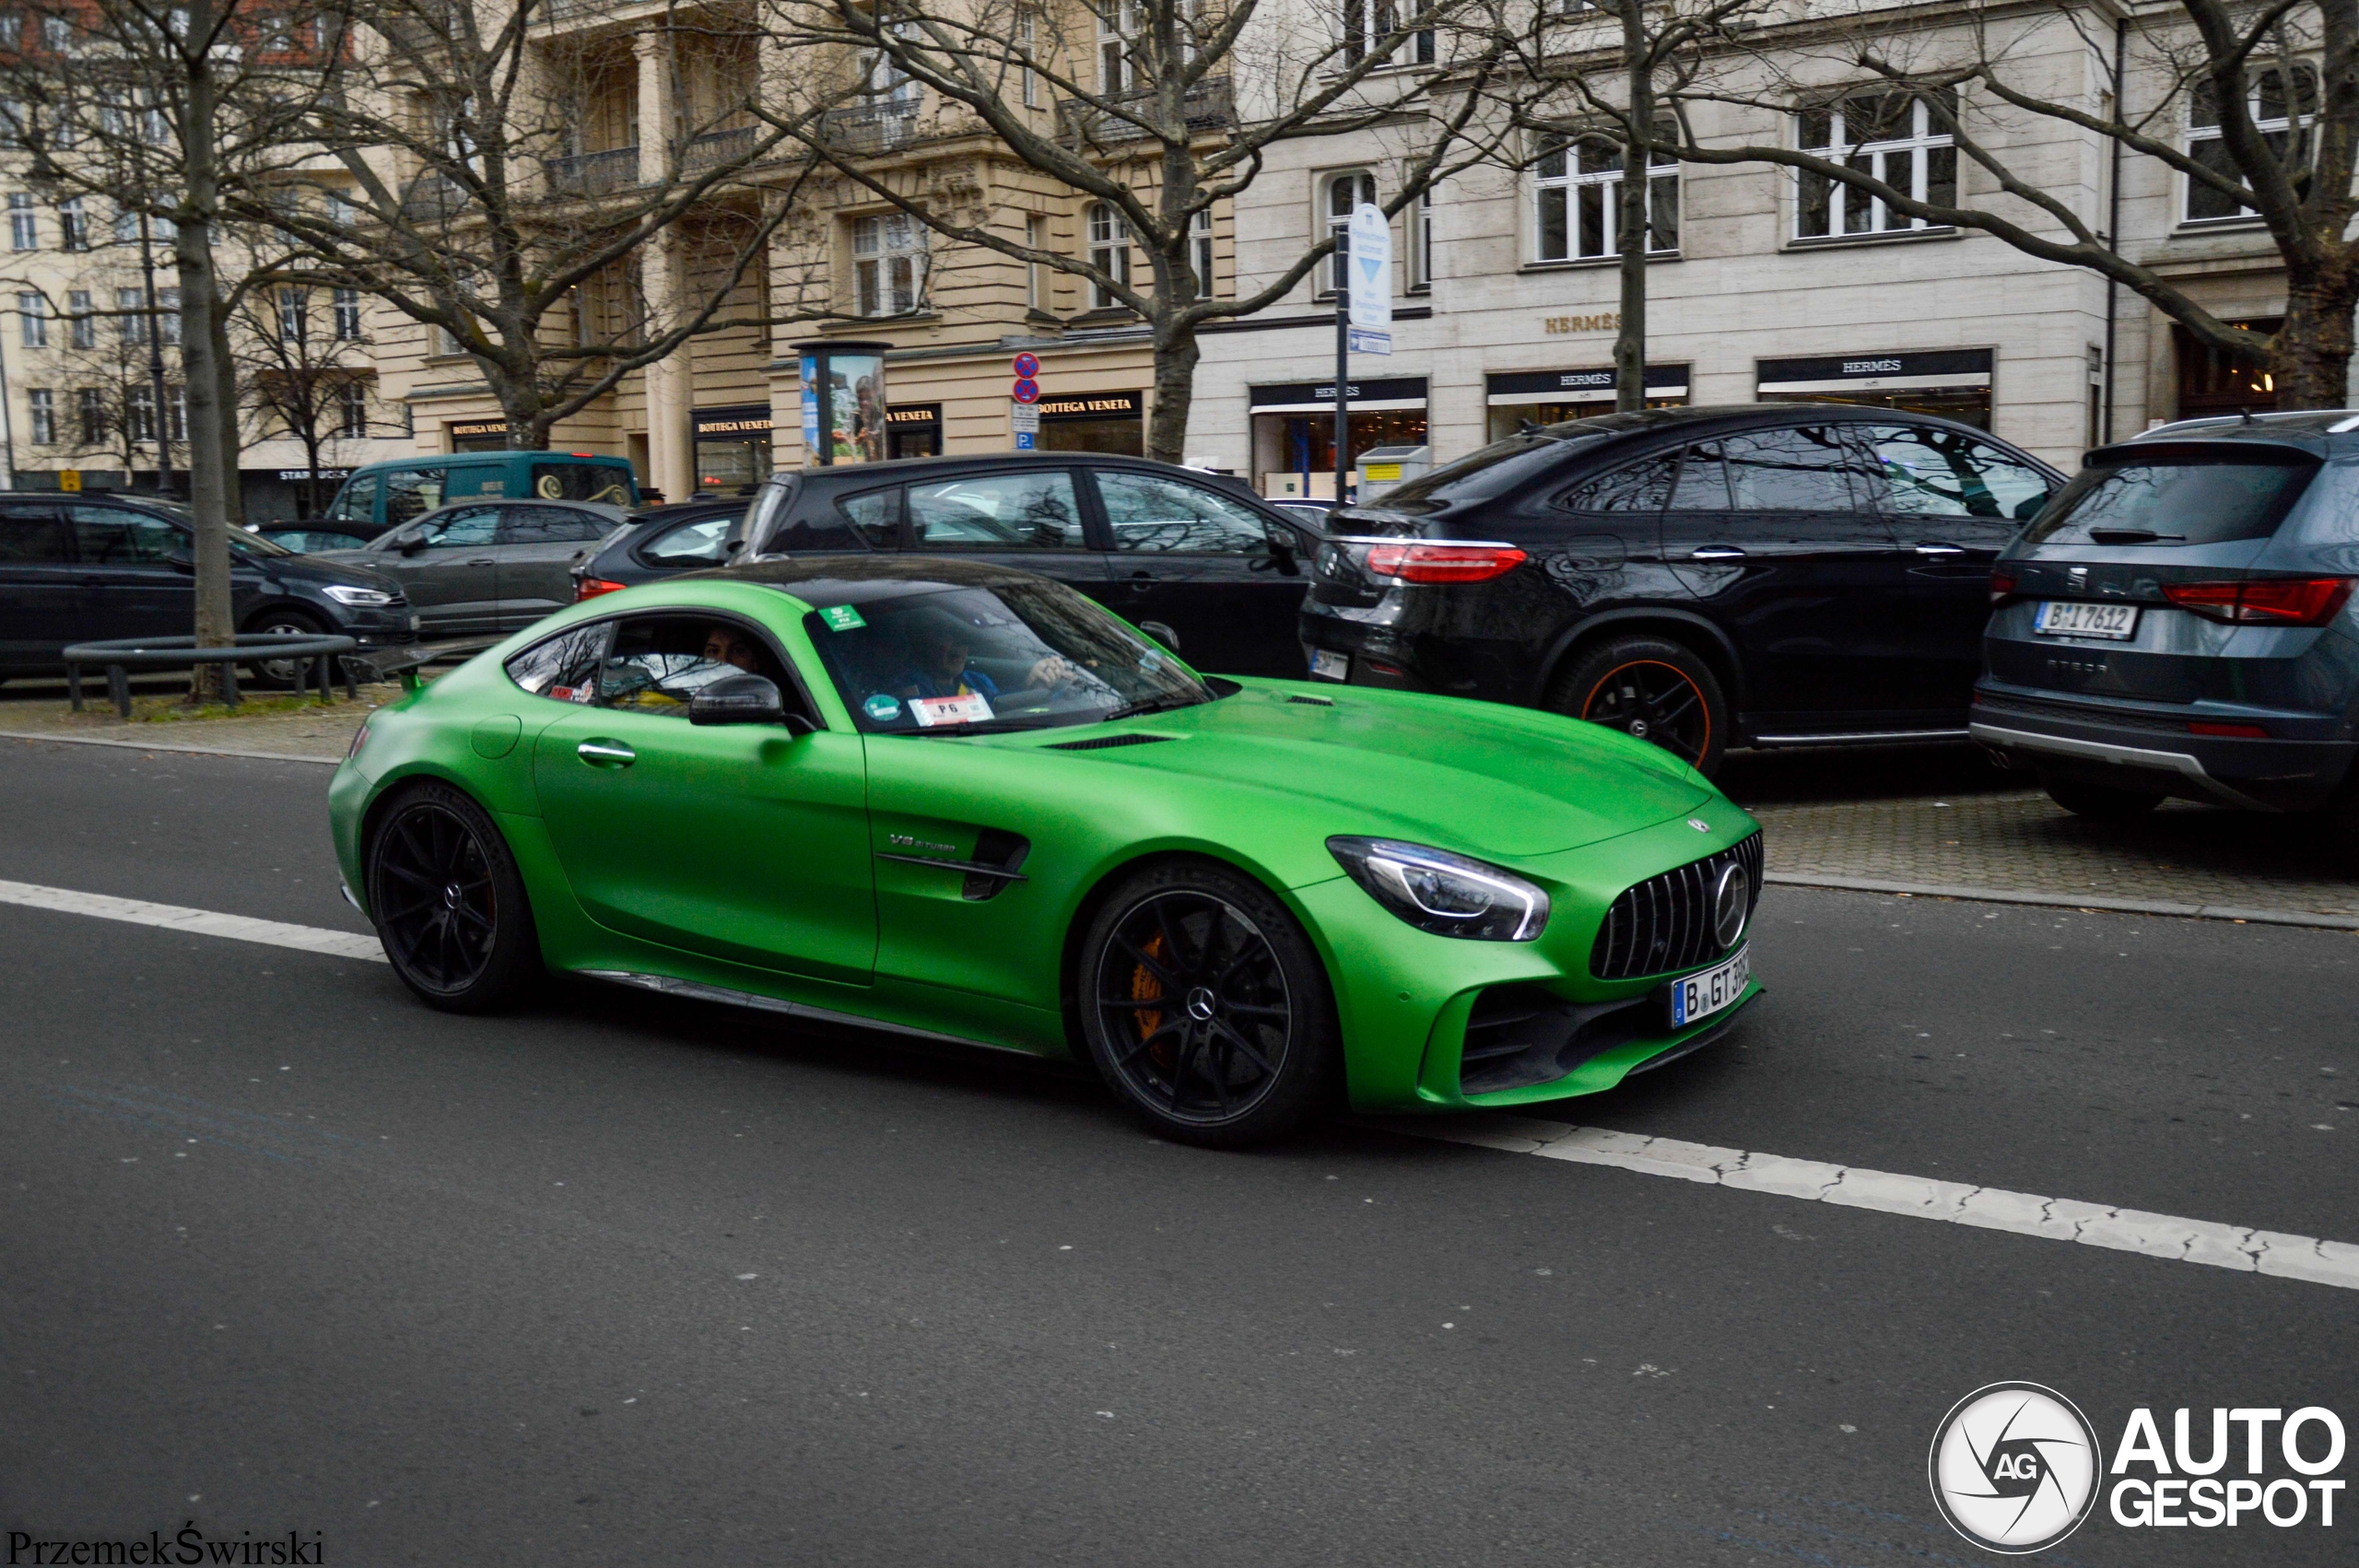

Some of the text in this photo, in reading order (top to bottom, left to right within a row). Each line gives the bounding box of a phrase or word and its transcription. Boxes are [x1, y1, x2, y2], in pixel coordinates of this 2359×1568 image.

[1545, 312, 1622, 334] HERMÈS
[1842, 359, 1902, 373] HERMÈS
[1560, 373, 1612, 386] HERMÈS
[1315, 385, 1360, 398] HERÈS
[1038, 399, 1132, 414] BOTTEGA VENETA
[894, 411, 933, 421] VENETA
[487, 423, 508, 432] VENE
[698, 419, 774, 433] BOTTEGA VENETA
[279, 470, 349, 480] STARUCS
[2050, 604, 2063, 626] B
[2083, 606, 2128, 631] 7612
[938, 703, 958, 714] P 6
[890, 834, 913, 846] V8
[1686, 982, 1698, 1018] B
[1711, 967, 1731, 1006] GT
